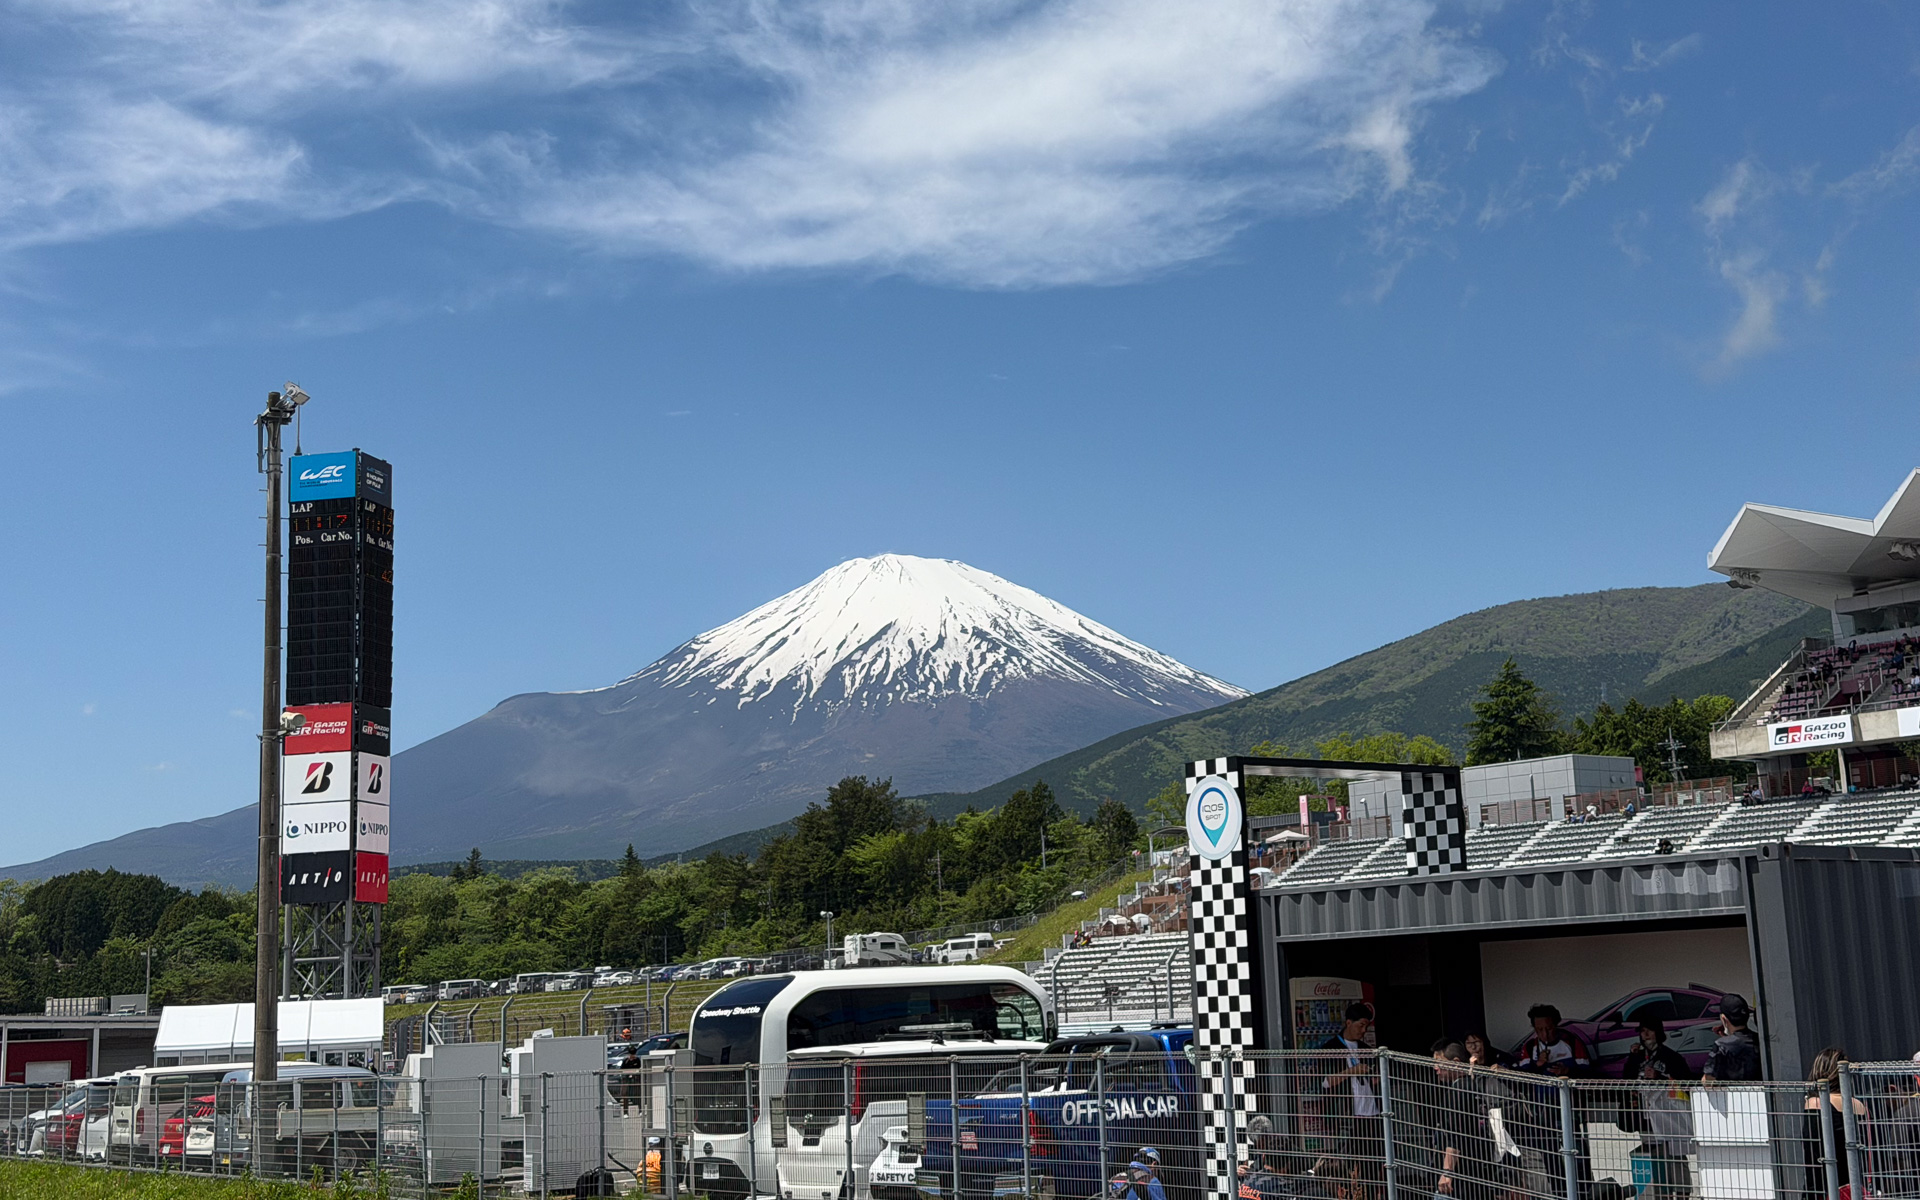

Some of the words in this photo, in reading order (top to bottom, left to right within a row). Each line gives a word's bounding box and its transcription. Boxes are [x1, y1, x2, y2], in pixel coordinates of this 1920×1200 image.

[300, 465, 346, 480] WEC
[292, 502, 313, 513] LAP
[365, 501, 377, 513] LAP
[295, 535, 314, 545] Pos.
[321, 532, 336, 542] Car
[338, 531, 352, 541] No.
[366, 533, 376, 545] Pos.
[378, 537, 387, 549] Car
[313, 727, 346, 735] Racing
[362, 725, 373, 735] GR
[374, 723, 390, 732] GAZOO
[1805, 722, 1846, 732] GAZOO
[1775, 731, 1801, 744] GR
[1804, 731, 1845, 741] Racing
[1202, 804, 1224, 813] IQOS
[304, 821, 347, 835] NIPPO
[368, 822, 388, 836] NIPPO
[288, 867, 342, 888] AKTIO
[360, 869, 386, 888] AKTIO
[700, 1009, 733, 1018] Speedway
[733, 1006, 760, 1015] Shuttle
[1062, 1097, 1144, 1125] OFFCIAL
[1143, 1095, 1178, 1118] CAR
[877, 1173, 906, 1182] SAFETY
[908, 1174, 916, 1182] C
